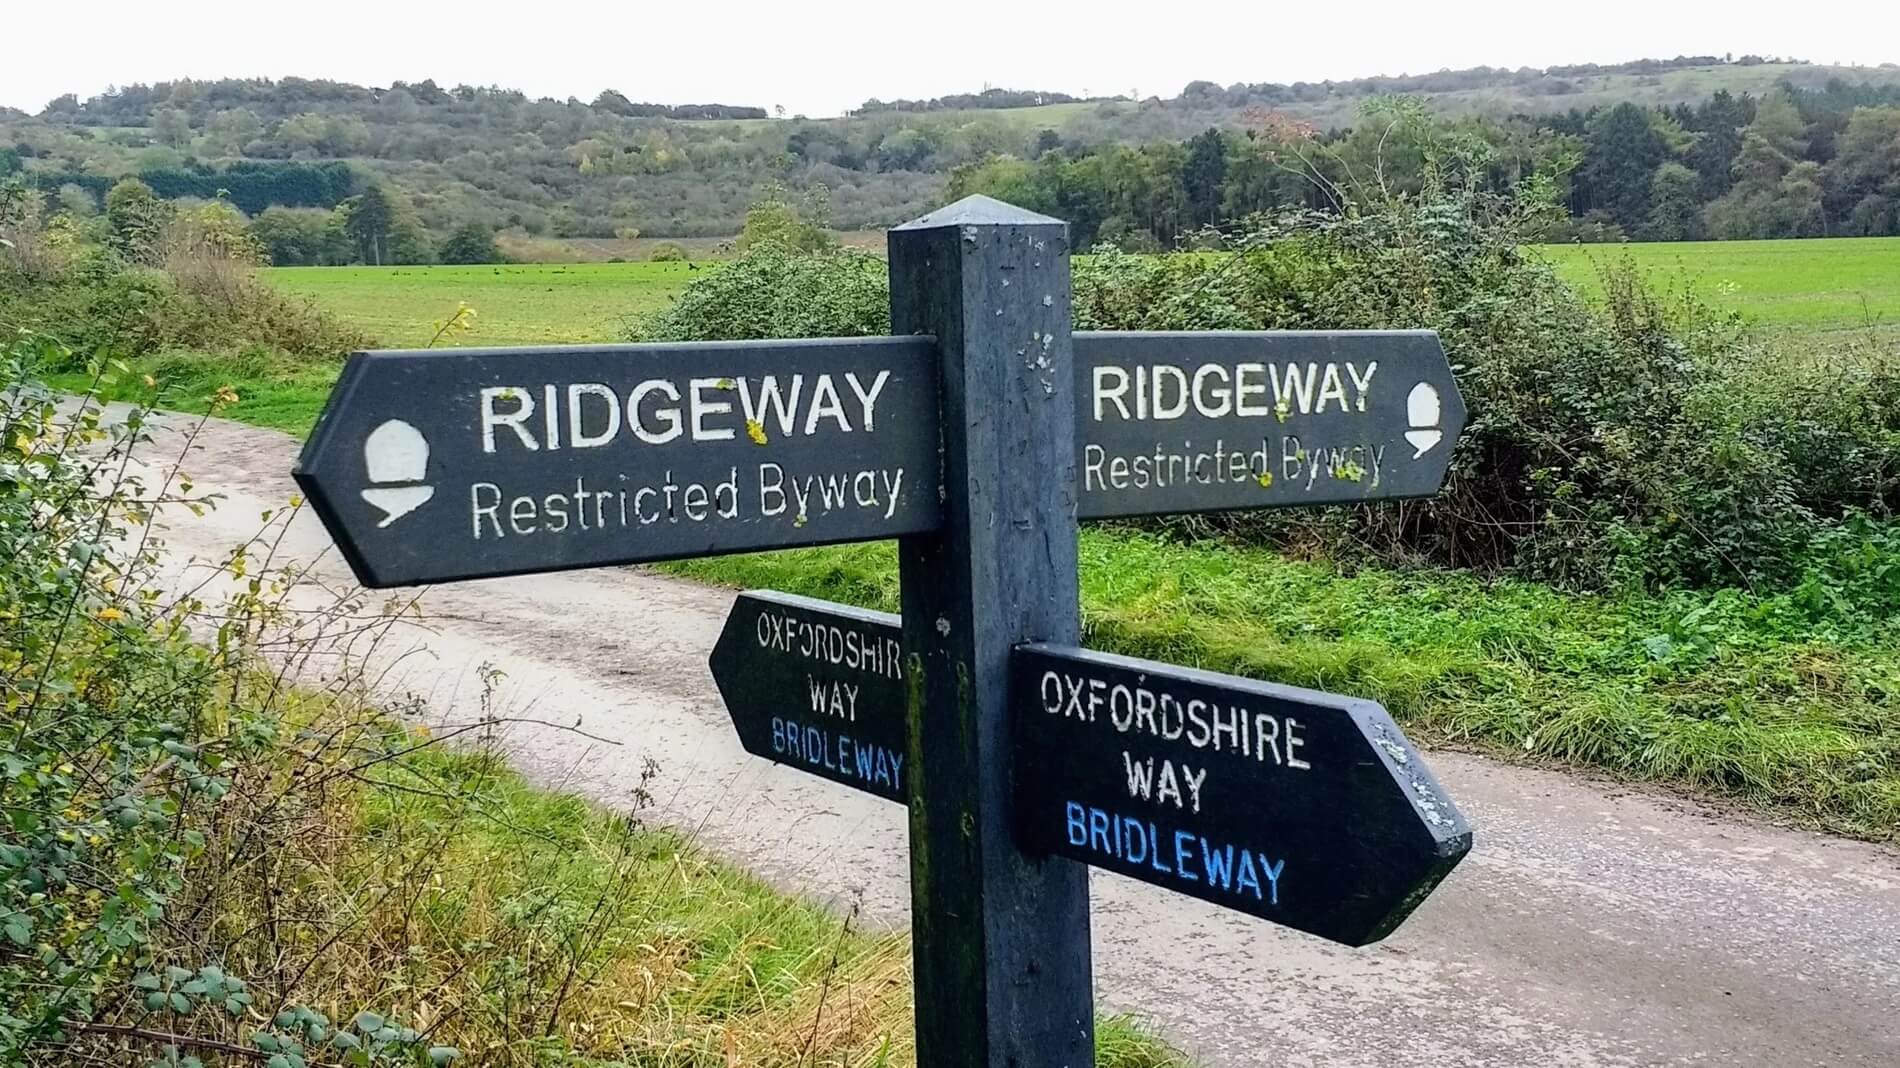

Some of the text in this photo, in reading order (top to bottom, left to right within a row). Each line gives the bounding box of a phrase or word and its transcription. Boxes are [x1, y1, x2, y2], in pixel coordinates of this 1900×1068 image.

[480, 370, 890, 453] RIDGEWAY
[1092, 360, 1379, 421] RIDGEWAY
[1084, 435, 1386, 491] Restricted Byway
[470, 462, 904, 539] Restricted Byway
[757, 611, 902, 680] OXFORDSHIR
[808, 673, 859, 722] WAY
[1041, 671, 1311, 770] OXFORDSHIRE
[772, 716, 904, 790] BRIDLEWAY
[1122, 750, 1207, 814] WAY
[1066, 800, 1285, 905] BRIDLEWAY
